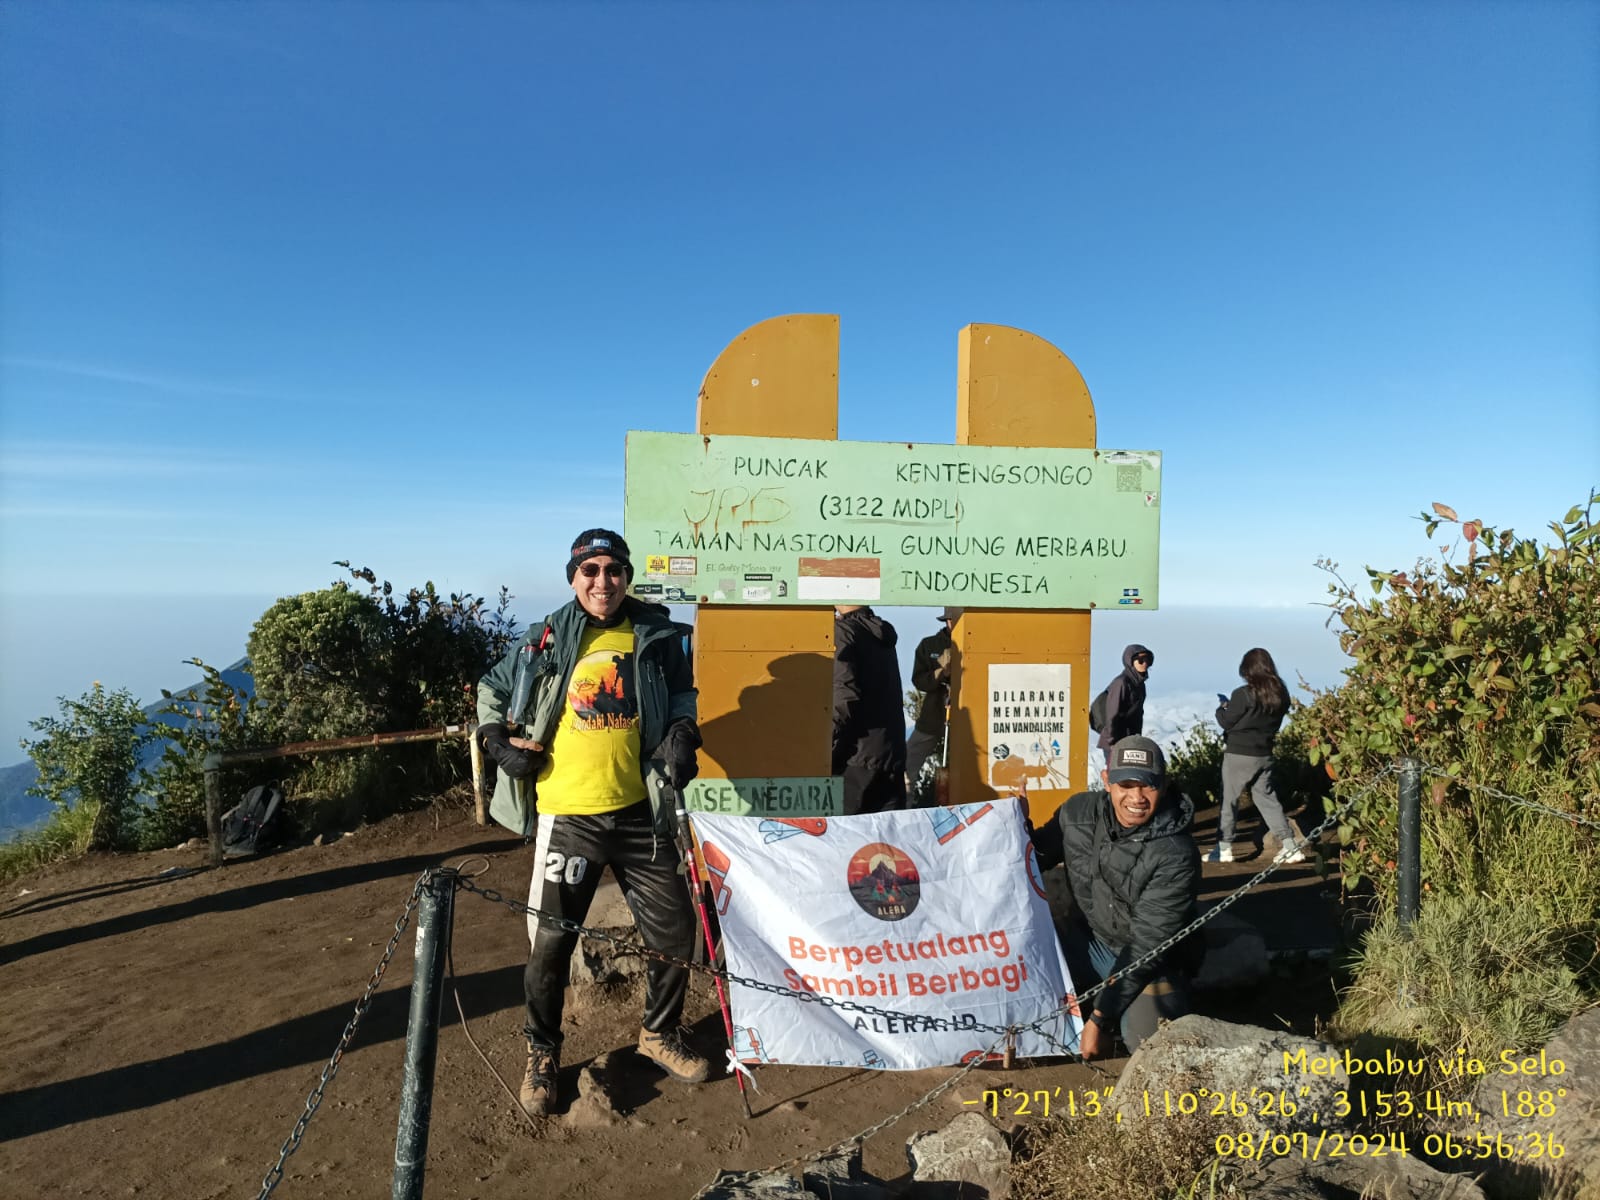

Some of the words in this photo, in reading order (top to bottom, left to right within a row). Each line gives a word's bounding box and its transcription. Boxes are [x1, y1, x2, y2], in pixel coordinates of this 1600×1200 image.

[734, 456, 828, 479] PUNCAK
[896, 463, 1092, 486] KENTENGSONGO
[820, 495, 883, 520] (3122
[893, 498, 964, 523] MDPL)
[654, 529, 743, 552] TAMAN
[754, 533, 883, 554] NASIONAL
[900, 535, 1005, 556] GUNUNG
[1016, 536, 1127, 558] MERBABU
[900, 571, 1049, 594] INDONESIA
[993, 691, 1064, 702] DILARANG
[607, 713, 632, 729] Nafas
[993, 707, 1065, 718] MEMANJAT
[993, 722, 1011, 733] DAN
[1012, 722, 1064, 733] VANDALISME
[1125, 751, 1145, 760] VANS
[690, 786, 746, 812] ASET
[752, 785, 834, 812] NEGARA
[545, 852, 588, 884] 20
[878, 905, 906, 915] ALERA
[788, 929, 1010, 971] Berpetualang
[783, 966, 898, 997] Sambil
[906, 955, 1028, 996] Berbagi
